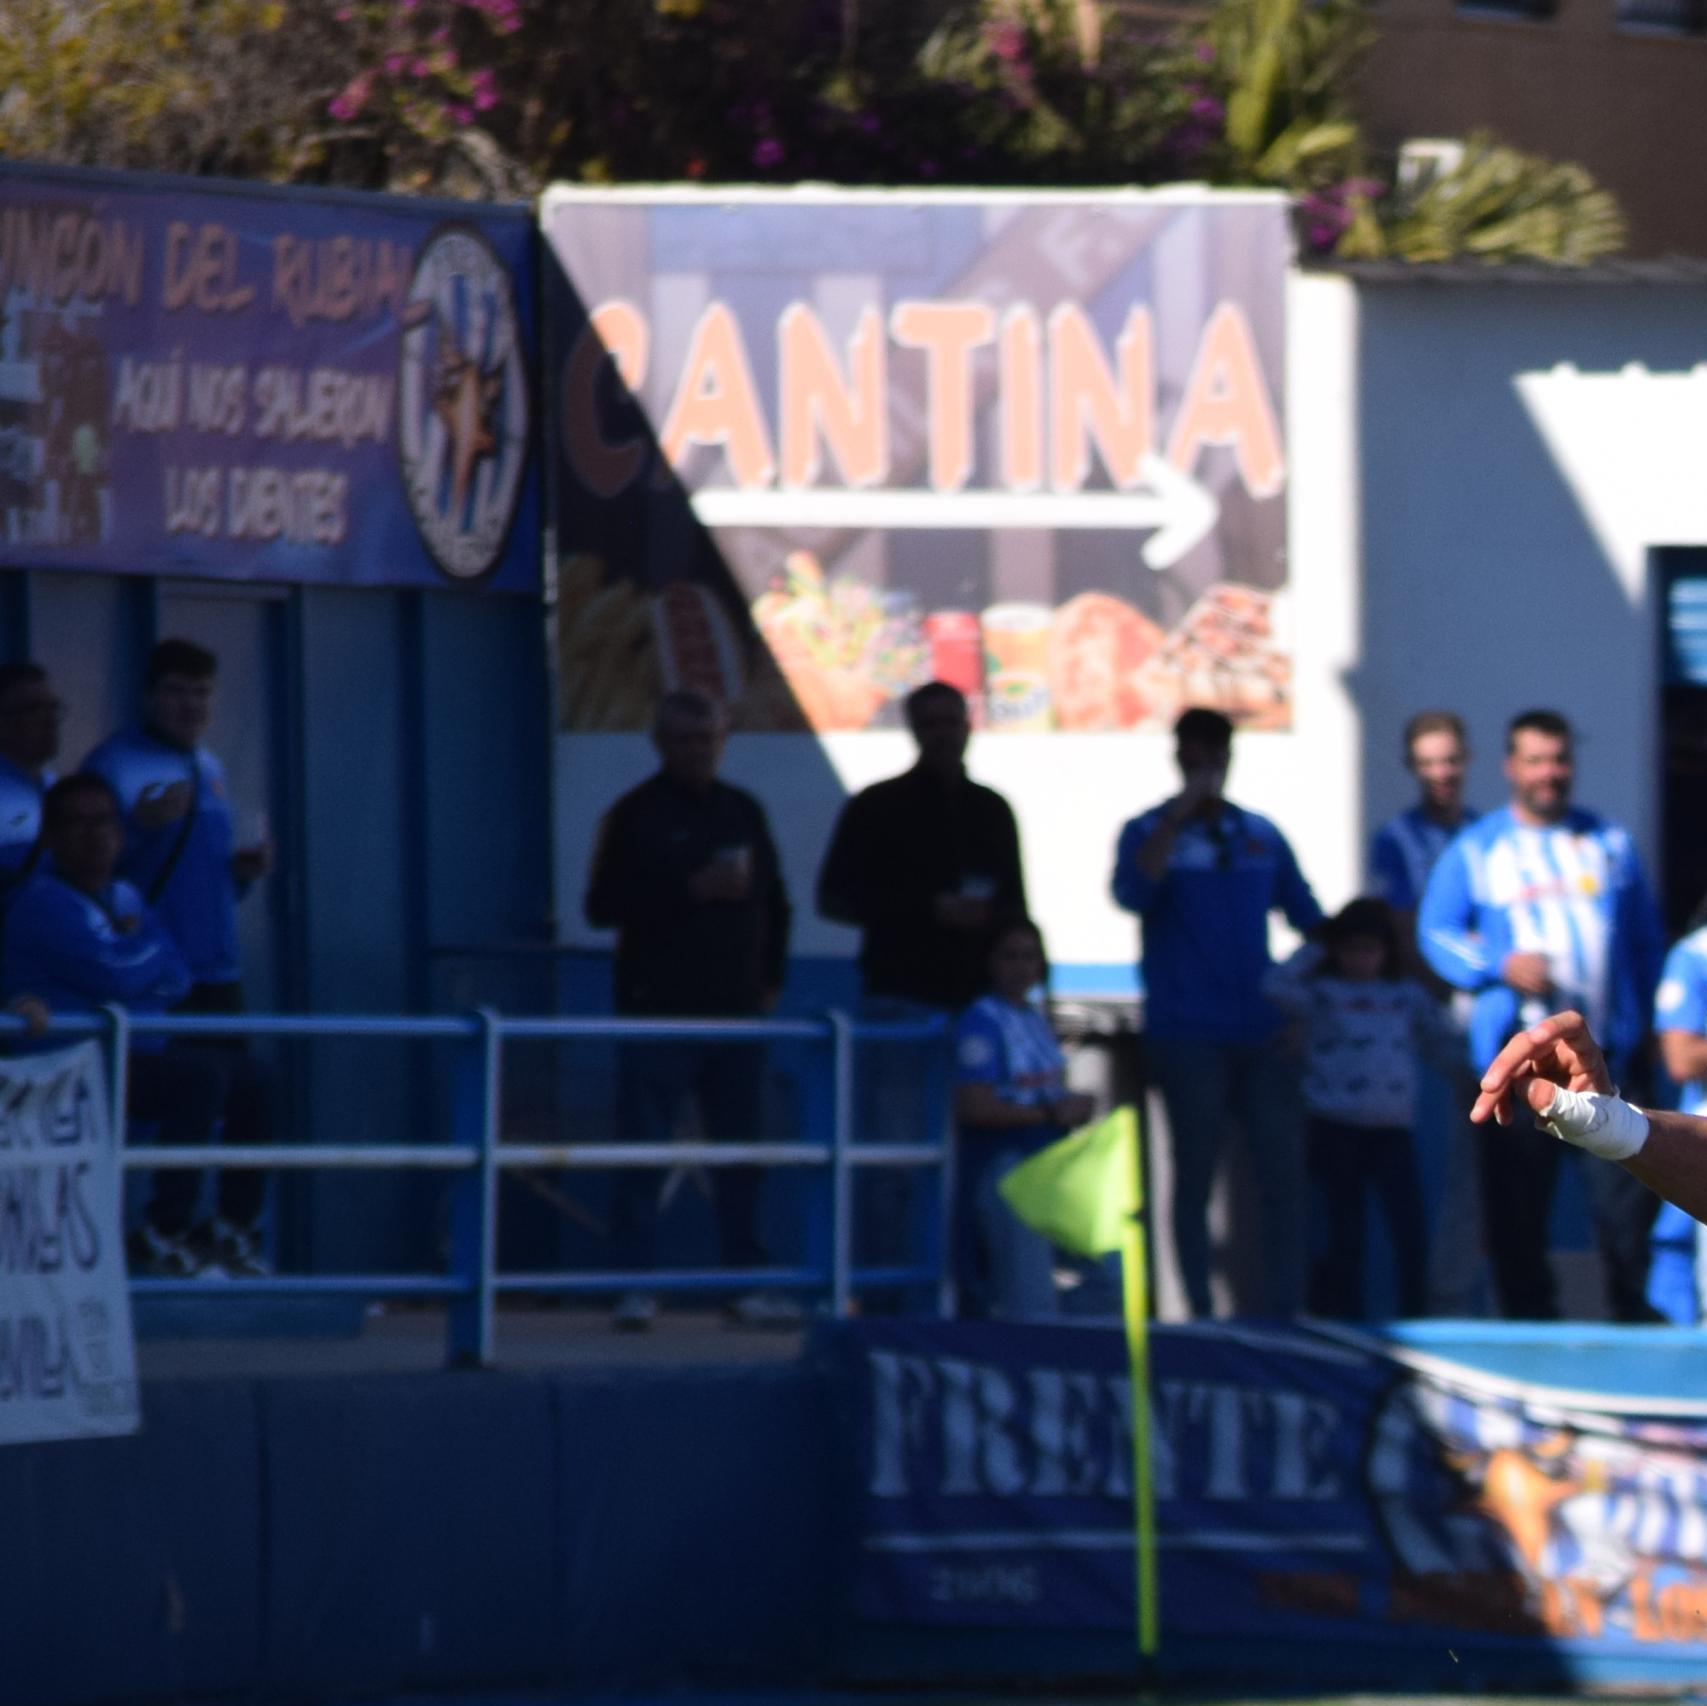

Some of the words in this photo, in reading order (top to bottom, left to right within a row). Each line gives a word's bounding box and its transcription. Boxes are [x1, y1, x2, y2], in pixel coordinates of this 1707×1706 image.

[0, 200, 147, 306] INCÓN
[160, 217, 257, 312] DEL
[112, 348, 184, 435] AQUÍ
[188, 362, 248, 438] NOS
[562, 298, 1287, 500] CANTINA
[164, 463, 222, 540] LOS
[228, 466, 350, 546] DIENTES
[867, 1347, 1342, 1503] FRENTE
